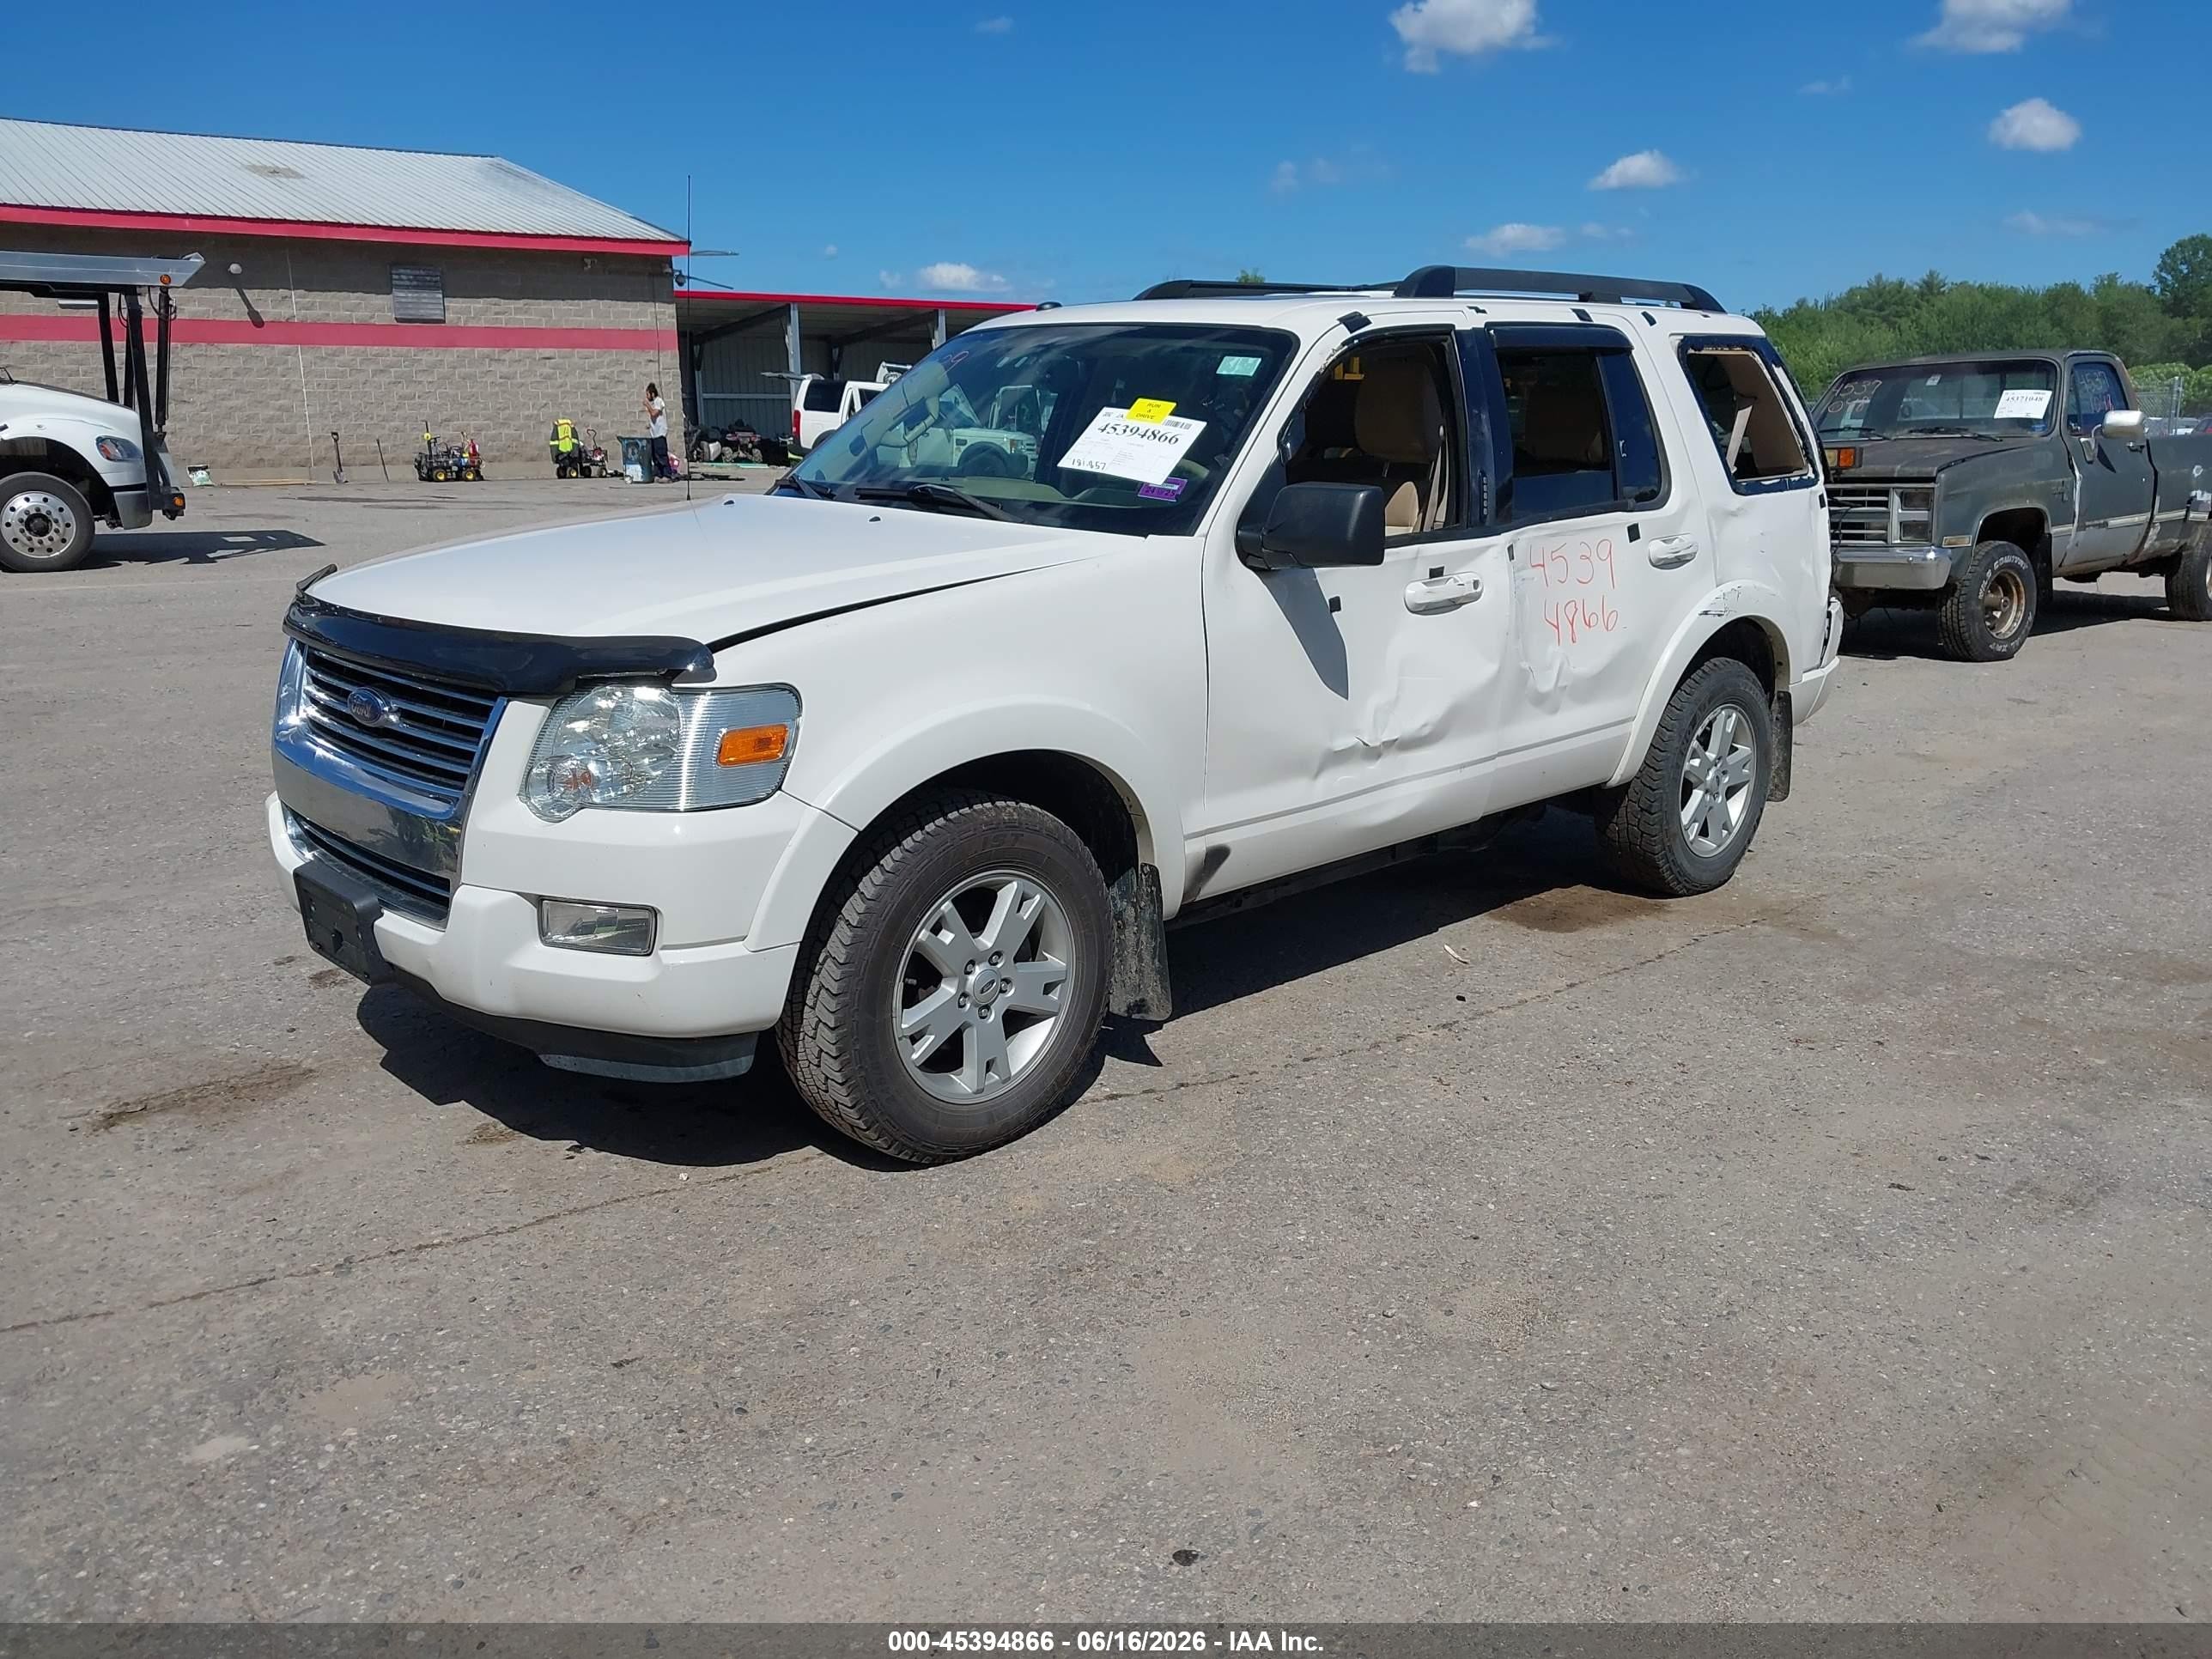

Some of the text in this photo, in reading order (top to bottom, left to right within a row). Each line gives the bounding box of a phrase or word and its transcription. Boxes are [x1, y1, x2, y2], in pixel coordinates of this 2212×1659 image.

[1832, 379, 1883, 397] 4537
[1097, 422, 1182, 446] 45394866
[1529, 538, 1615, 589] 4539
[1993, 555, 2028, 571] COUNTRY
[1544, 594, 1619, 647] 4866
